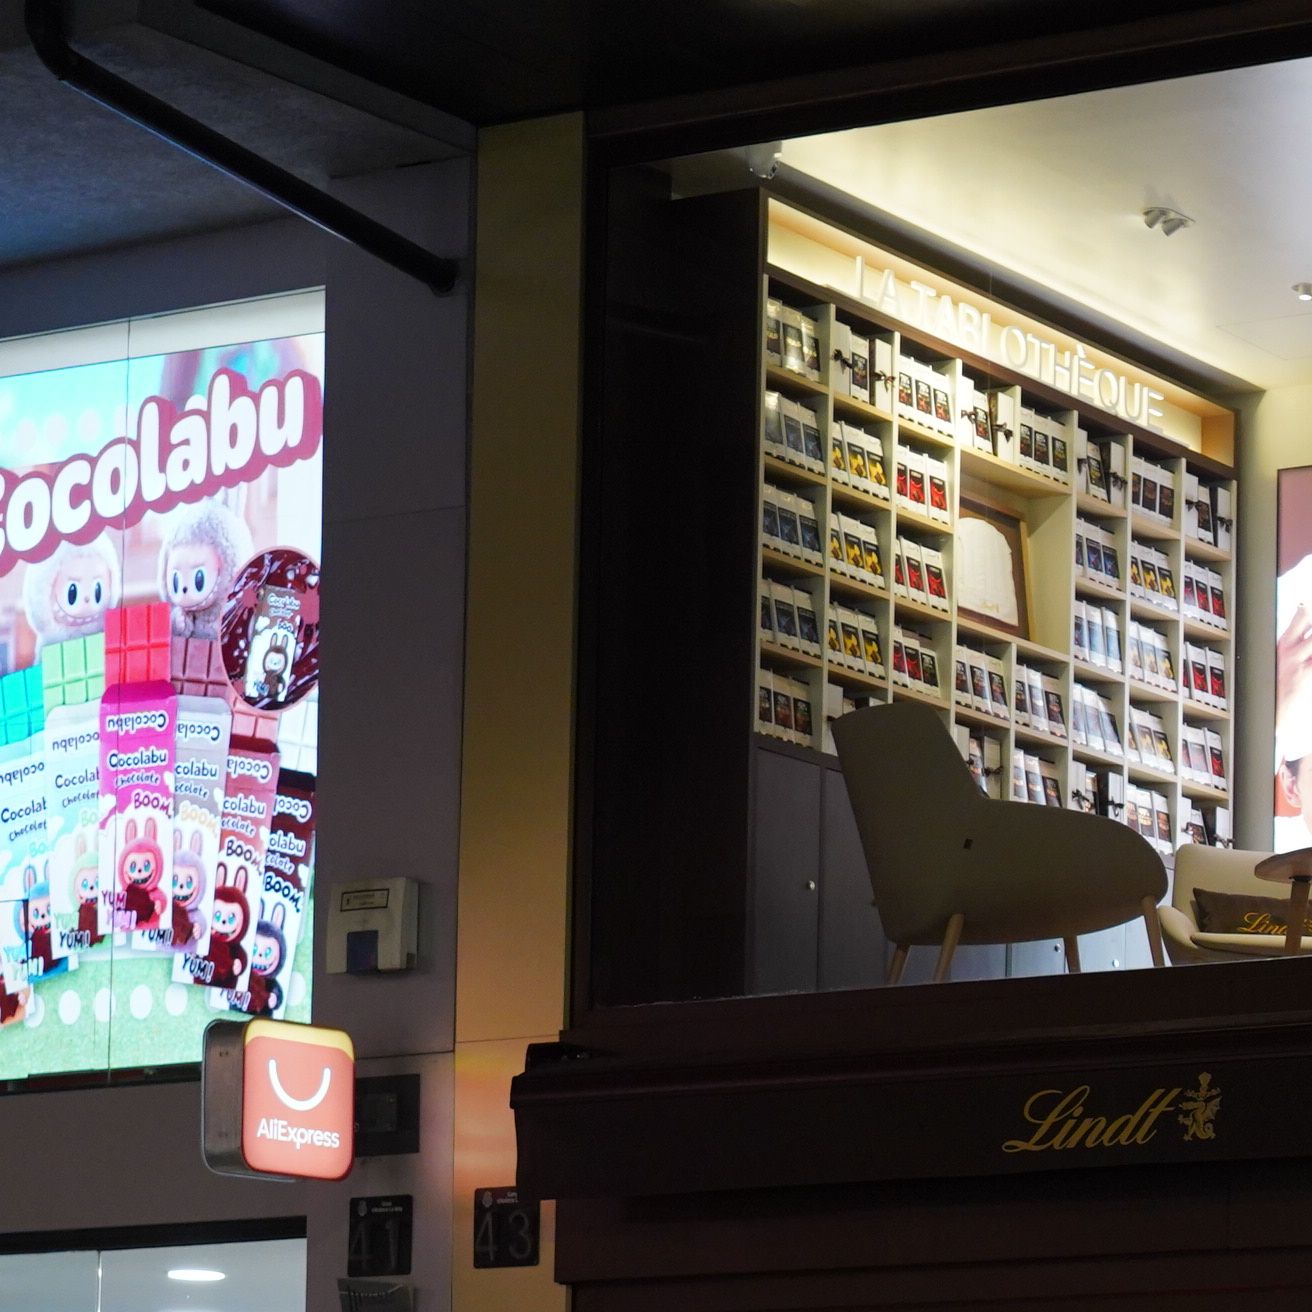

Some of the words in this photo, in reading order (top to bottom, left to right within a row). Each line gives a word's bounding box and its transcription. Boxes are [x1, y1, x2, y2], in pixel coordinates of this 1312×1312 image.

[854, 255, 902, 319] LA
[0, 372, 306, 554] ocolabu
[107, 713, 167, 732] Cocolabu
[177, 722, 220, 741] Cocola
[52, 731, 100, 751] ocolabu
[108, 748, 168, 768] Cocolabu
[175, 761, 218, 778] colabu
[226, 757, 272, 780] Cocola
[0, 761, 45, 786] ocolabu
[222, 797, 266, 816] colabu
[273, 794, 311, 819] Cocol
[268, 835, 305, 854] olabu
[1236, 911, 1288, 935] Lin
[1001, 1085, 1184, 1153] Lindt
[256, 1118, 340, 1150] AliExpress
[475, 1210, 532, 1262] 43
